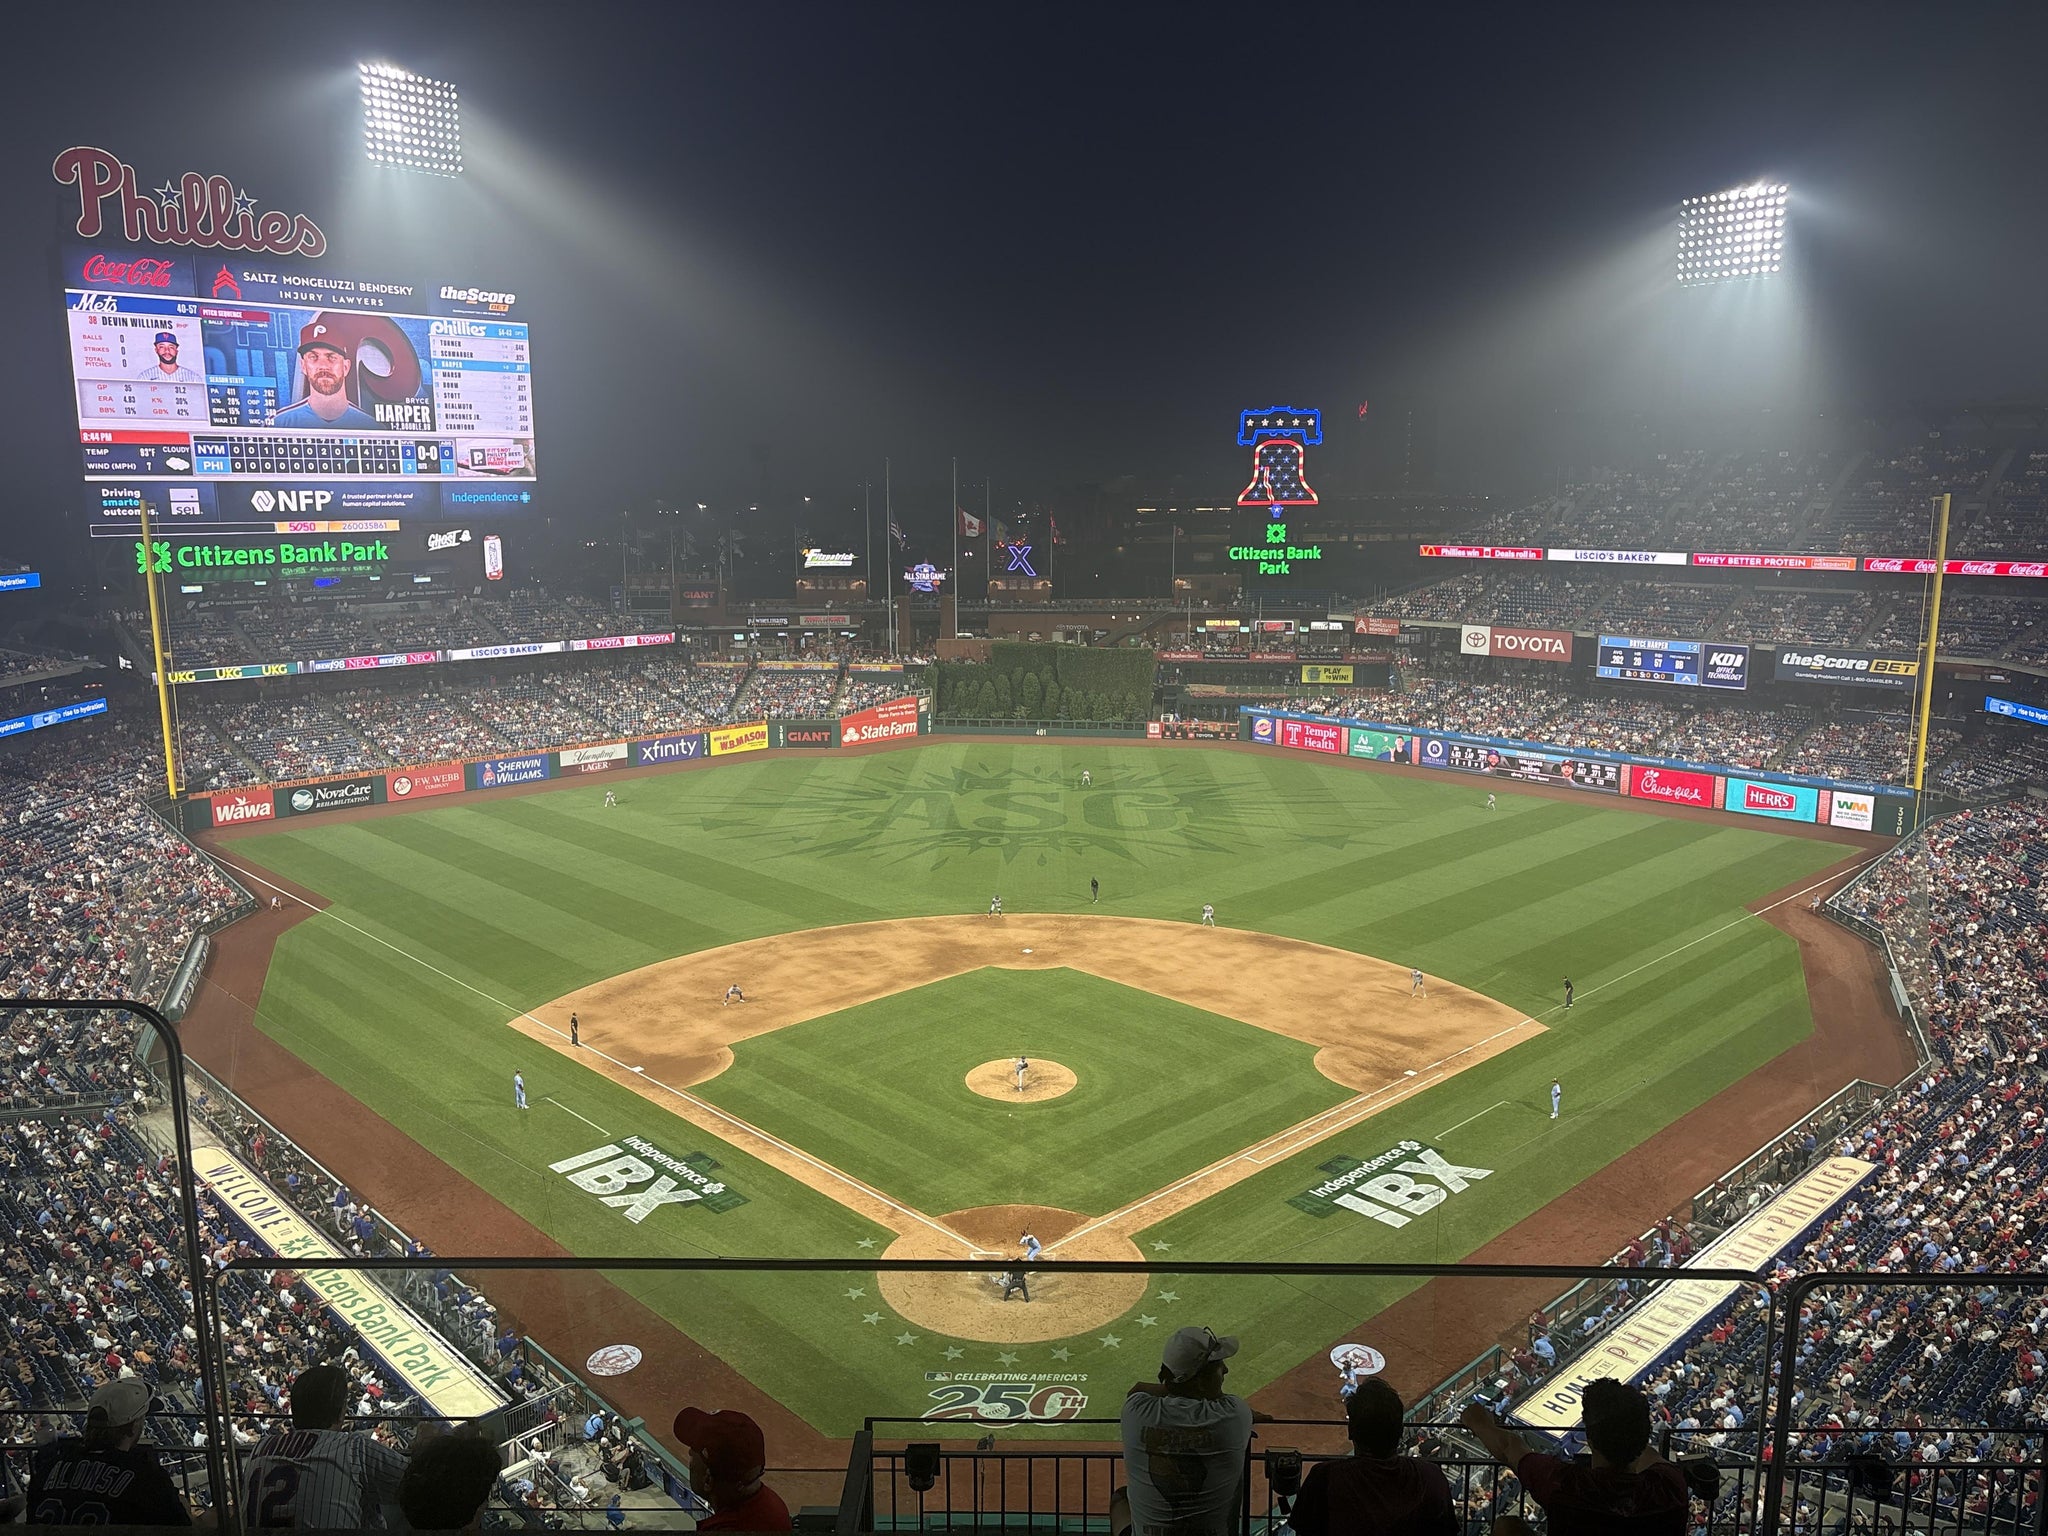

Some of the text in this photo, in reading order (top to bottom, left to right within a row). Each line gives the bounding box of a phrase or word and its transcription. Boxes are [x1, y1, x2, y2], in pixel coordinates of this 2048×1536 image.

[53, 146, 327, 258] Phillies
[83, 254, 175, 287] Coca-Cola
[243, 271, 413, 296] SALTZ MONGELUZZI BENDESKY
[279, 291, 384, 306] INJURY LAWYERS
[440, 286, 515, 304] theScore
[72, 293, 118, 312] Mets
[102, 316, 128, 327] DEVIN
[130, 317, 173, 330] WILLIAMS
[428, 319, 487, 337] phillies
[374, 404, 431, 423] HARPER
[100, 432, 112, 442] PM
[197, 444, 226, 455] NYM
[417, 445, 438, 461] 0-0
[203, 461, 224, 470] PHI
[101, 488, 141, 498] Driving
[452, 492, 519, 504] Independence
[278, 490, 332, 512] NFP
[177, 540, 389, 567] Citizens Bank Park
[1229, 545, 1322, 560] Citizens Bank
[1441, 548, 1466, 556] Phillies
[1466, 548, 1480, 556] win
[1574, 551, 1657, 563] LISCIO'S BAKERY
[1259, 561, 1290, 575] Park
[1698, 556, 1806, 568] WHEY BETTER PROTEIN
[1869, 560, 1903, 571] Coca-Cola
[1961, 562, 1997, 574] Coca-Cola
[2008, 563, 2045, 575] Coca-Cola
[904, 572, 946, 580] ALL STAR GAME
[683, 591, 715, 599] GIANT
[590, 638, 622, 649] TOYOTA
[639, 634, 670, 645] TOYOTA
[1494, 634, 1565, 654] TOYOTA
[410, 652, 436, 663] NECA
[471, 644, 544, 658] LISCIO'S BAKERY
[349, 658, 376, 668] NECA
[1782, 652, 1915, 673] theScore BET
[216, 667, 242, 680] UKG
[261, 664, 288, 676] UKG
[1708, 672, 1743, 681] TECHNOLOGY
[1716, 666, 1735, 674] OFFICE
[168, 672, 196, 683] UKG
[80, 702, 105, 714] hydration
[787, 732, 831, 742] GIANT
[1305, 726, 1337, 739] Temple
[642, 738, 697, 761] xfinity
[1304, 737, 1335, 750] Health
[573, 749, 615, 763] Yuengling
[497, 759, 541, 772] SHERWIN
[581, 761, 609, 772] LAGER
[414, 773, 459, 786] F.W. WEBB
[315, 784, 371, 800] NovaCare
[1641, 774, 1701, 800] Chick-fil-A
[315, 796, 370, 808] REHABILITATION
[1750, 790, 1790, 807] HERR'S
[216, 803, 271, 822] Wawa
[848, 791, 1193, 832] ASG
[1837, 800, 1868, 813] WM
[1895, 807, 1904, 835] 330
[940, 834, 1095, 848] 2026
[622, 1135, 707, 1186] Independence
[1308, 1146, 1405, 1198] Independence
[548, 1143, 703, 1225] IBX
[1332, 1148, 1495, 1229] IBX
[206, 1163, 290, 1230] WELCOME
[1767, 1163, 1860, 1230] PHILLIES
[351, 1305, 451, 1390] Bank Park
[954, 1373, 1088, 1382] CELEBRATING AMERICA'S
[43, 1460, 136, 1498] ALONSO
